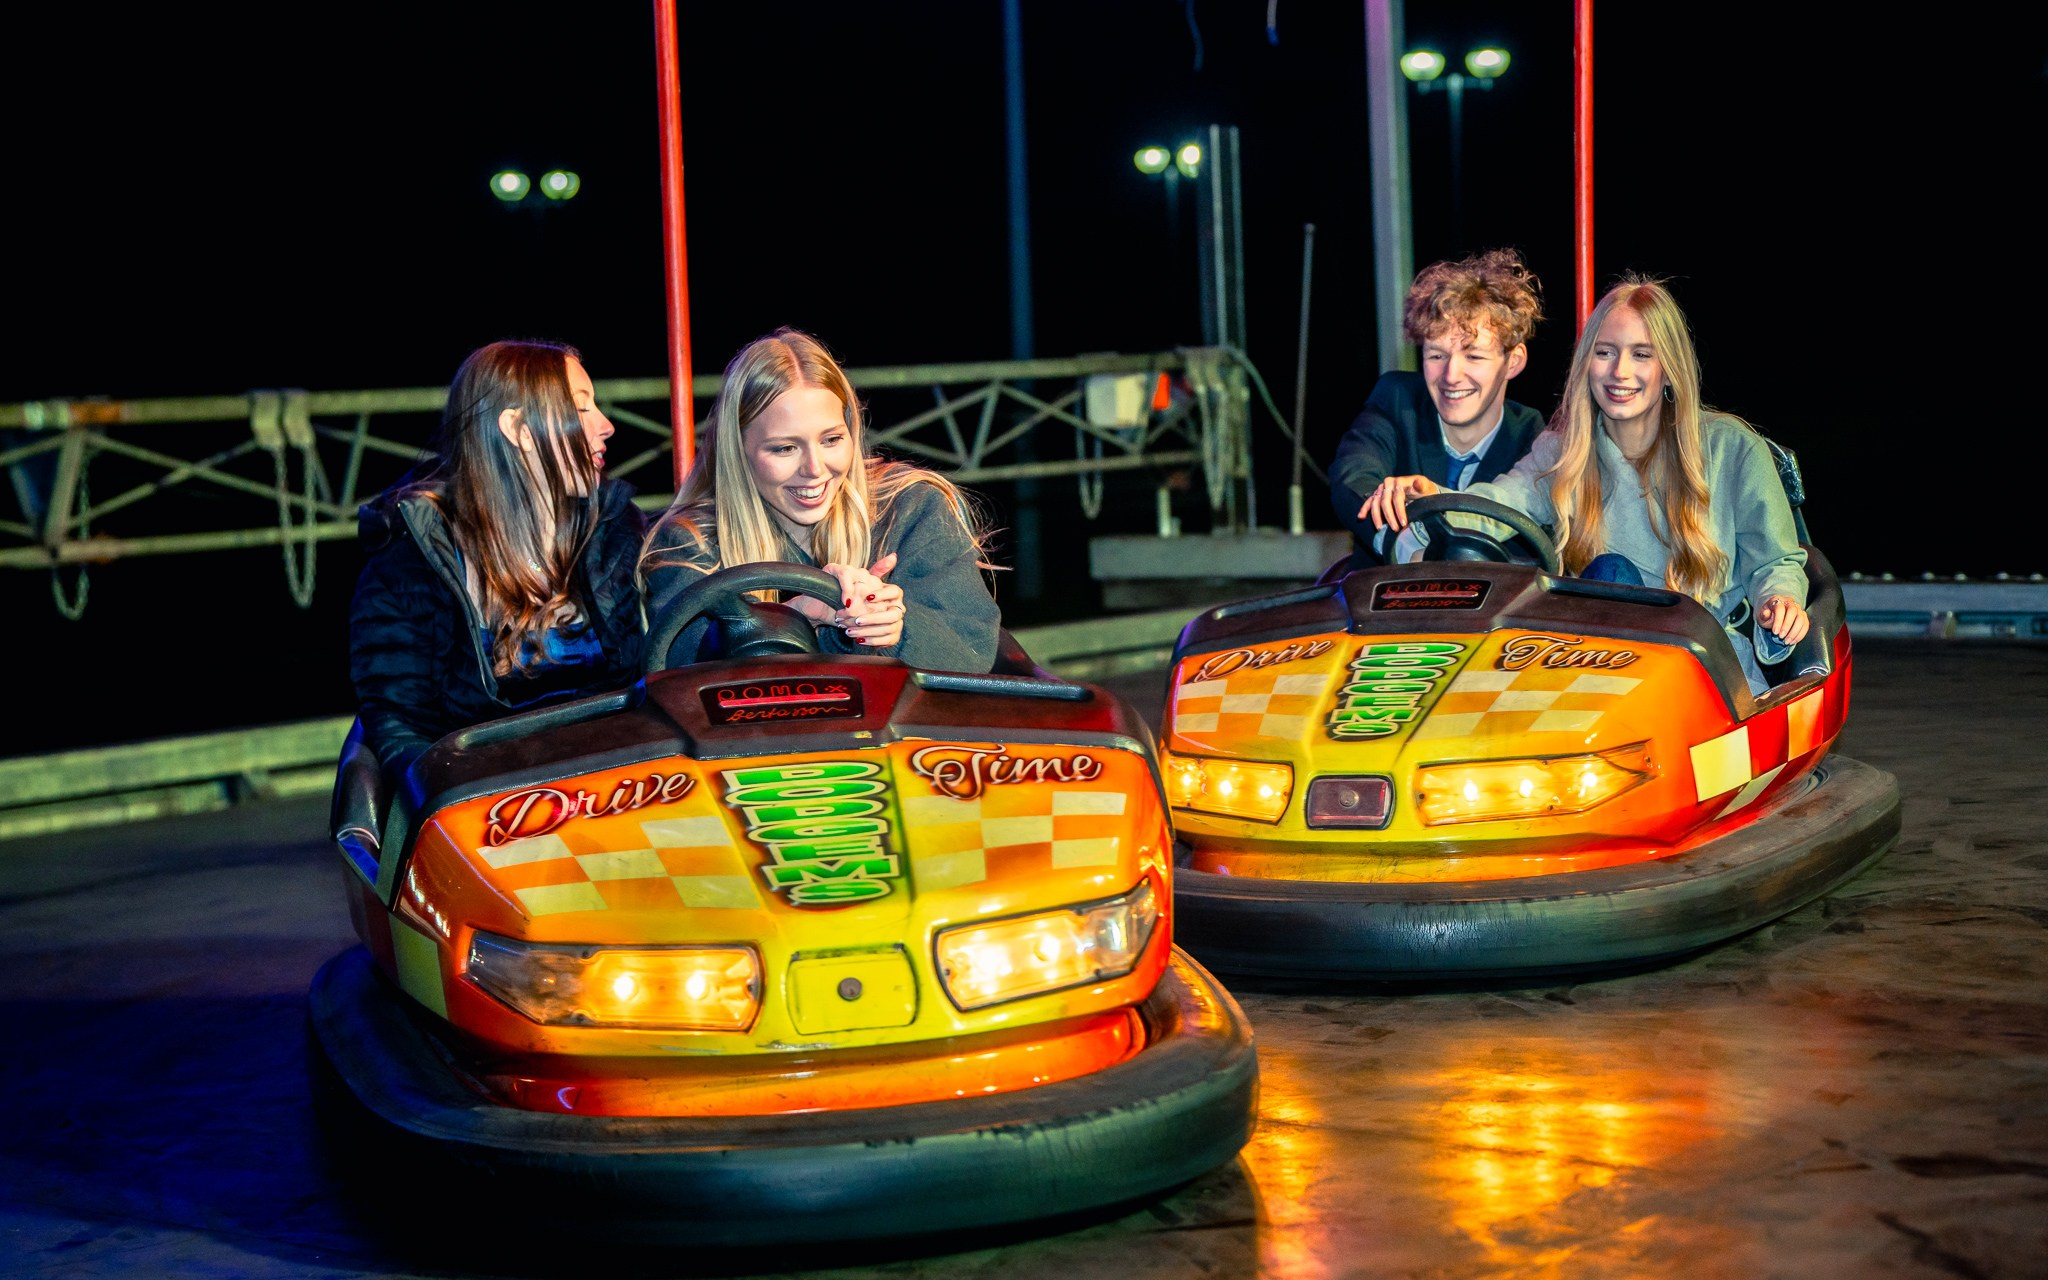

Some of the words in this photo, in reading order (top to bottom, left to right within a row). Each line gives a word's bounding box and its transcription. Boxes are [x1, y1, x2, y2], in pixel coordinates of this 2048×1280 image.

[1193, 640, 1336, 683] Drive
[1502, 634, 1638, 671] Time
[1330, 642, 1466, 737] DODGEMS
[911, 743, 1103, 802] Time
[488, 772, 697, 847] Drive
[720, 761, 901, 904] DODGEMS
